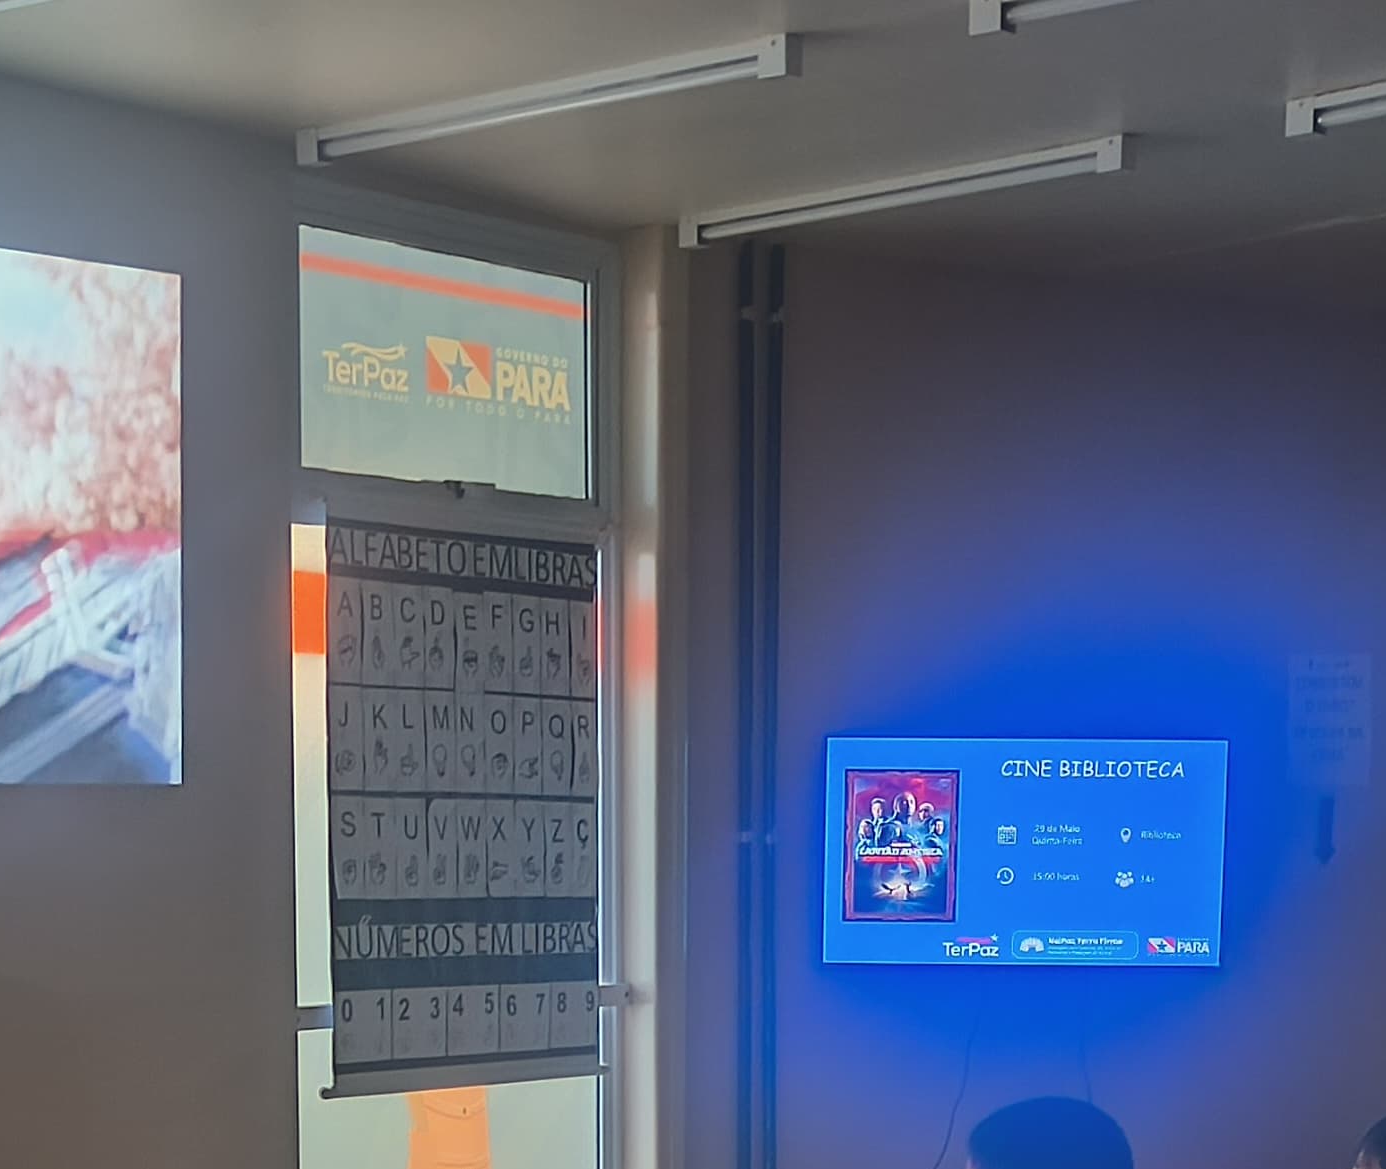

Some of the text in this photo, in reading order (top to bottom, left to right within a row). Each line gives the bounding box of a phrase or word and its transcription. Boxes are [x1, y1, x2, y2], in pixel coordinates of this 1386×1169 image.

[323, 350, 409, 393] TerPaz
[331, 527, 597, 586] ALFABETO EM LIBRAS
[337, 591, 587, 640] A B C D E F G H I
[338, 702, 590, 739] J K L M N O P Q R
[1001, 760, 1185, 778] CINE BIBLIOTECA
[340, 811, 590, 849] S T U V W X Y Z Ç
[333, 915, 464, 960] NÚMEROS
[521, 921, 598, 954] LIBRAS
[942, 942, 999, 957] TerPaz
[341, 991, 595, 1022] 0 1 2 3 4 5 6 7 8 9
